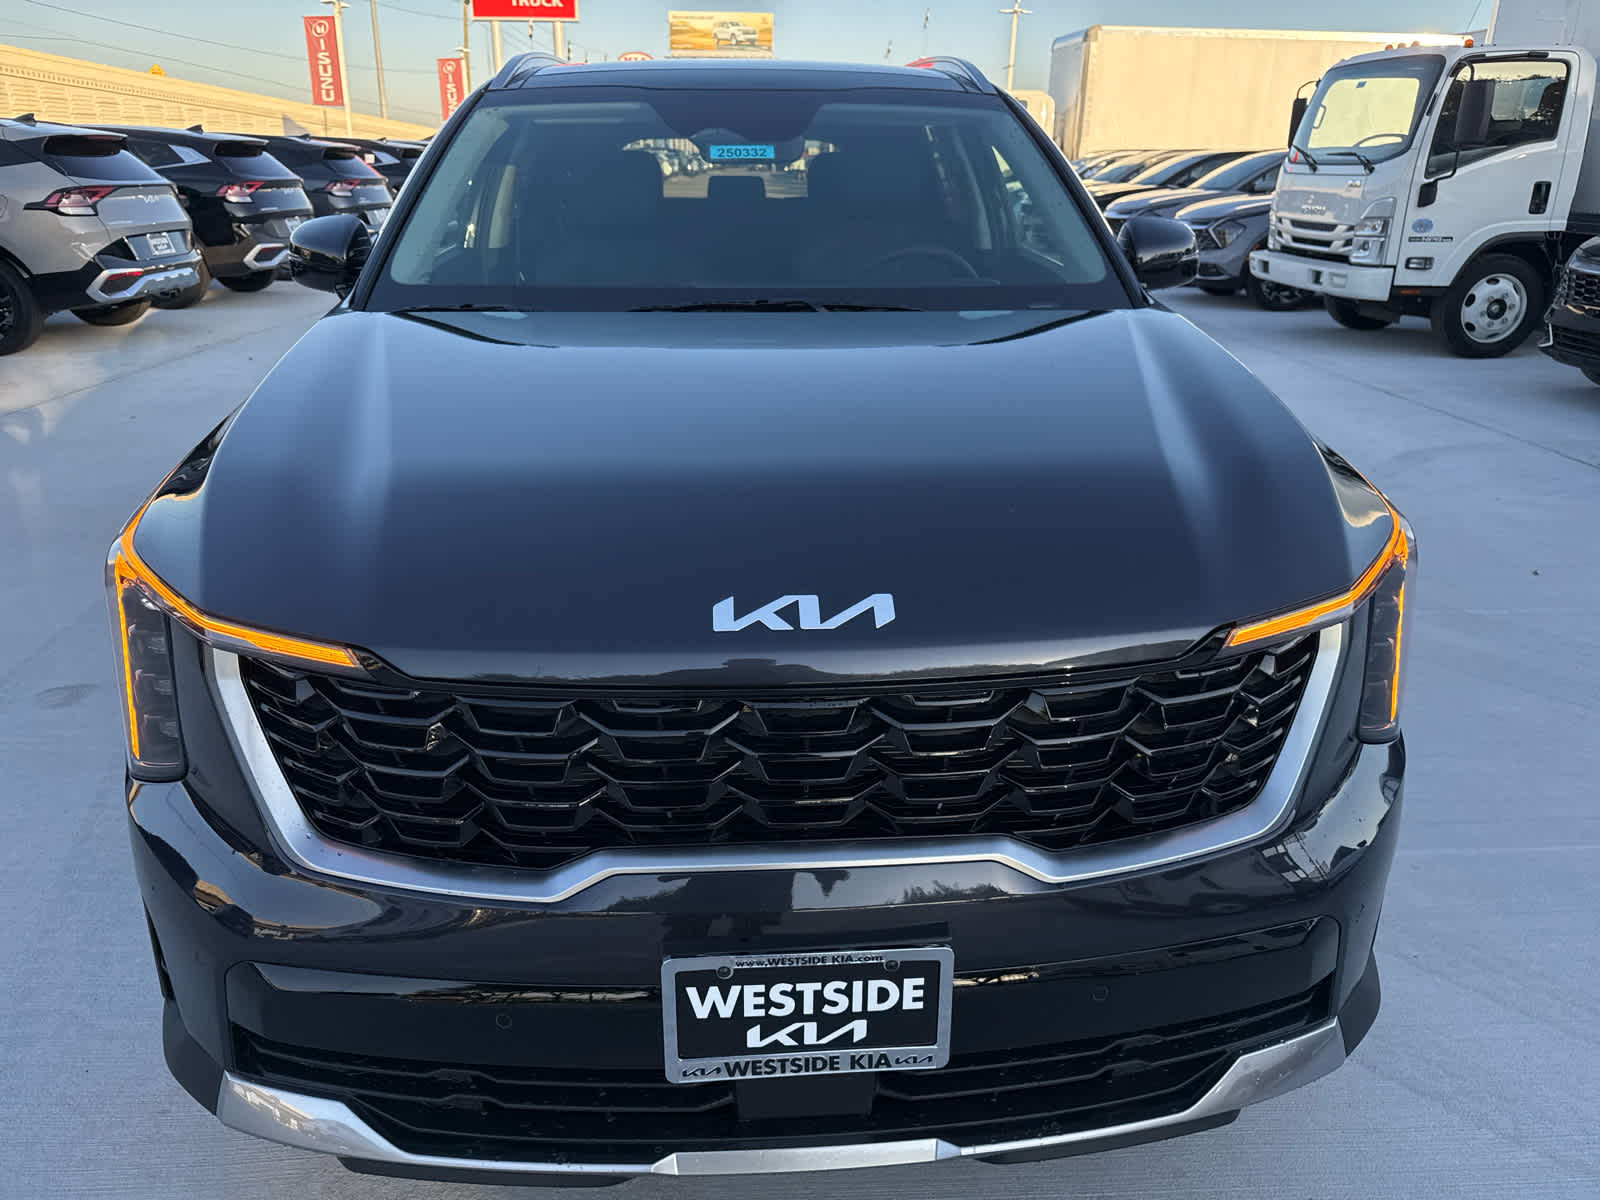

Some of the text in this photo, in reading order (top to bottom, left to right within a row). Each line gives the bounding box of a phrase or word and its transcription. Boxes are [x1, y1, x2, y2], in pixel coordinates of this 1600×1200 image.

[317, 38, 336, 102] ISUZU
[445, 72, 459, 117] ISUZ
[717, 148, 767, 158] 250332
[713, 593, 896, 632] KIA
[735, 955, 883, 968] www.WESTSIDE KIA.com
[685, 977, 925, 1019] WESTSIDE
[746, 1019, 868, 1048] KIA
[724, 1055, 841, 1078] WESTSIDE
[850, 1053, 892, 1070] KIA
